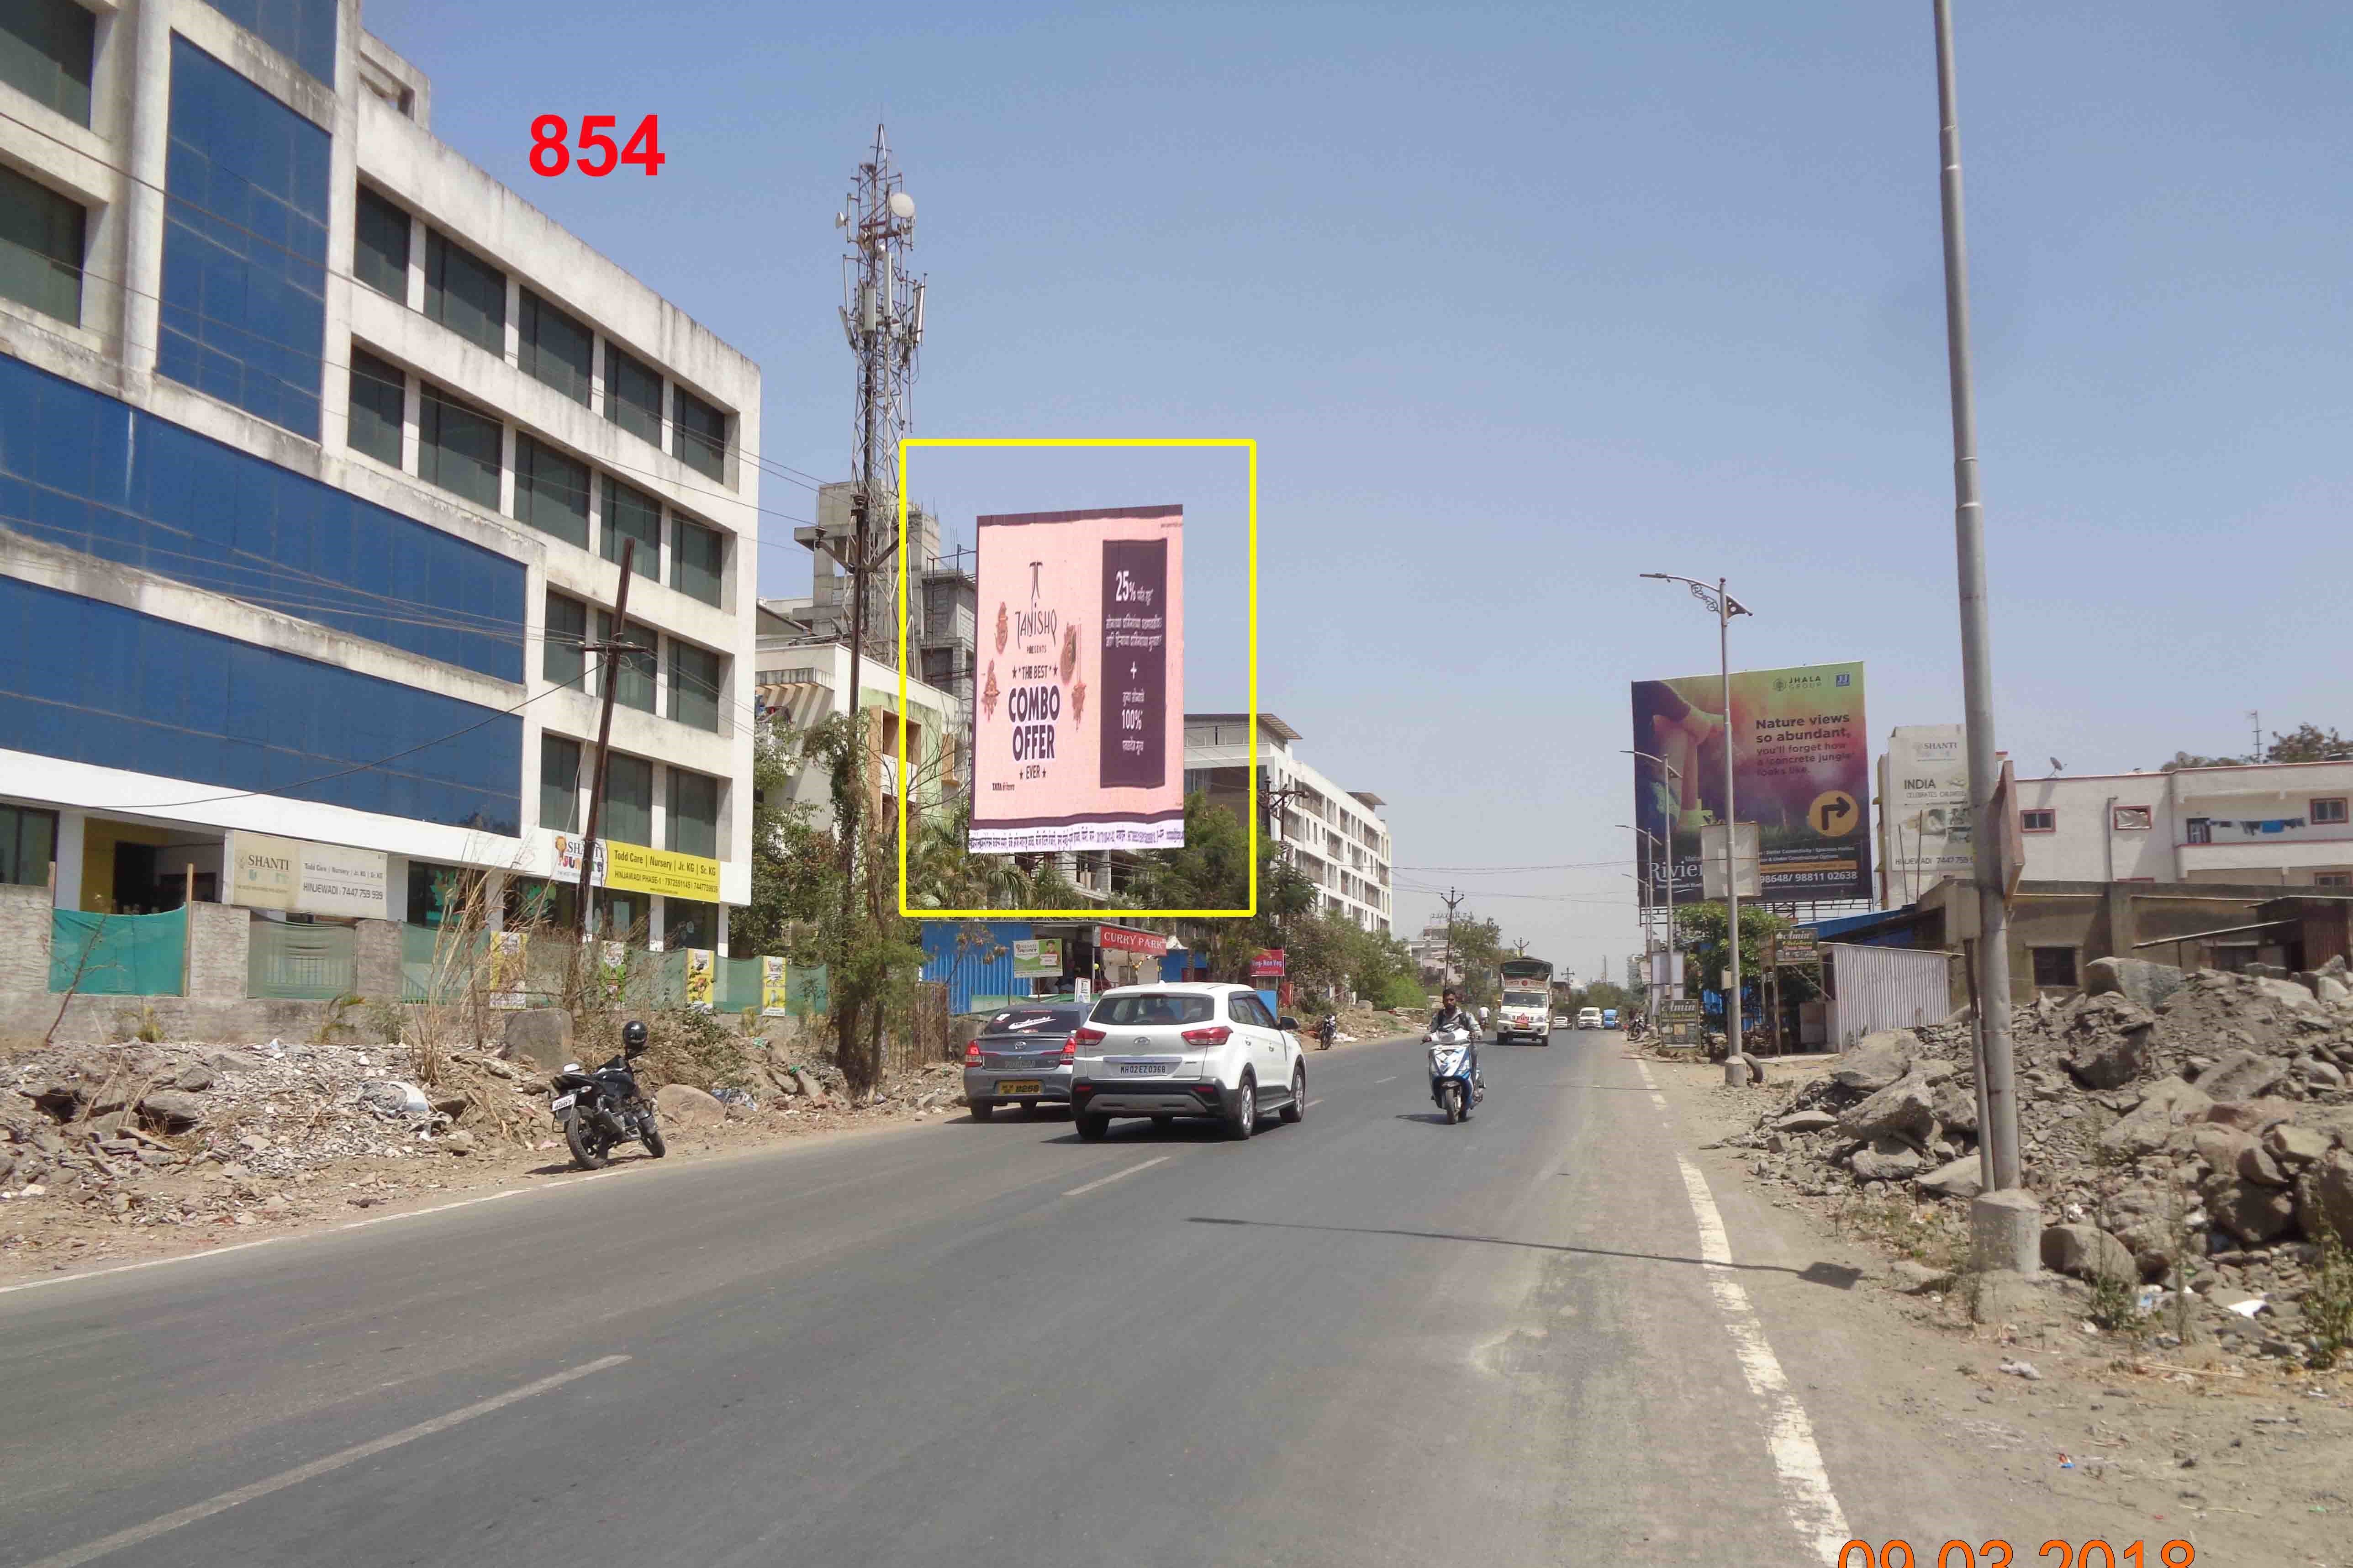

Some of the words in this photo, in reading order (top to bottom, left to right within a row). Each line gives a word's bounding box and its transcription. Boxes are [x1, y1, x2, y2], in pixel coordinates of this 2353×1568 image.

[1116, 570, 1136, 602] 25%
[1015, 608, 1057, 649] TANISHQ
[1034, 665, 1048, 679] BEST
[1008, 686, 1060, 723] COMBO
[1756, 718, 1804, 729] Nature
[1809, 714, 1850, 724] views
[1013, 724, 1055, 761] OFFER
[1788, 744, 1821, 753] forget
[1026, 765, 1040, 779] EVER
[992, 782, 1002, 791] TATA
[1904, 779, 1936, 790] INDIA
[248, 855, 289, 870] SHANTI
[614, 850, 628, 861] Todd
[630, 853, 643, 864] Care
[650, 856, 672, 871] Nursery
[686, 862, 694, 872] KG
[709, 867, 716, 876] KG
[1795, 873, 1824, 882] 98811
[1827, 871, 1857, 880] 02638
[1104, 932, 1136, 944] CURRY
[1139, 938, 1162, 949] PARK
